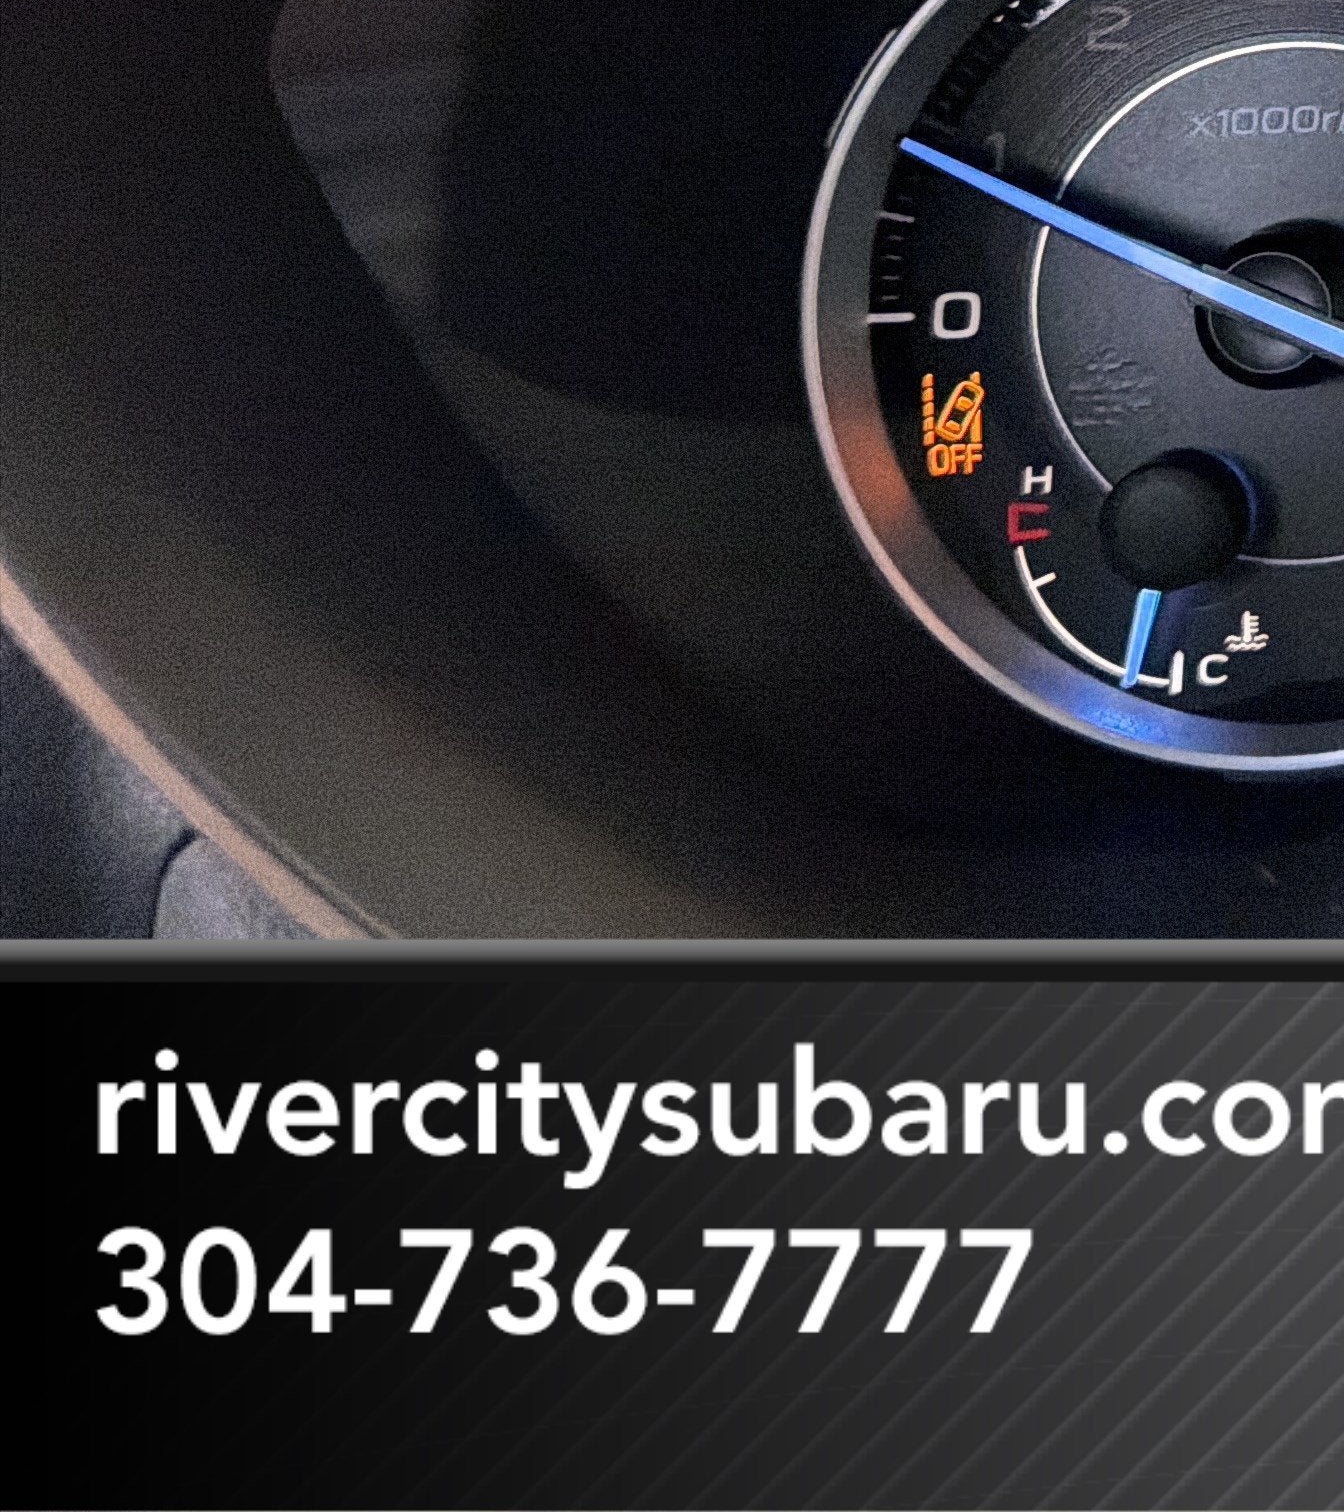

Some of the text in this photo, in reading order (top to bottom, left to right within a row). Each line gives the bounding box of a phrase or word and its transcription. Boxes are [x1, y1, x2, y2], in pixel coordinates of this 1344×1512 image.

[1086, 5, 1130, 53] 2
[933, 292, 980, 339] 0
[926, 443, 982, 476] OFF
[1023, 466, 1052, 494] H
[1198, 654, 1228, 685] C
